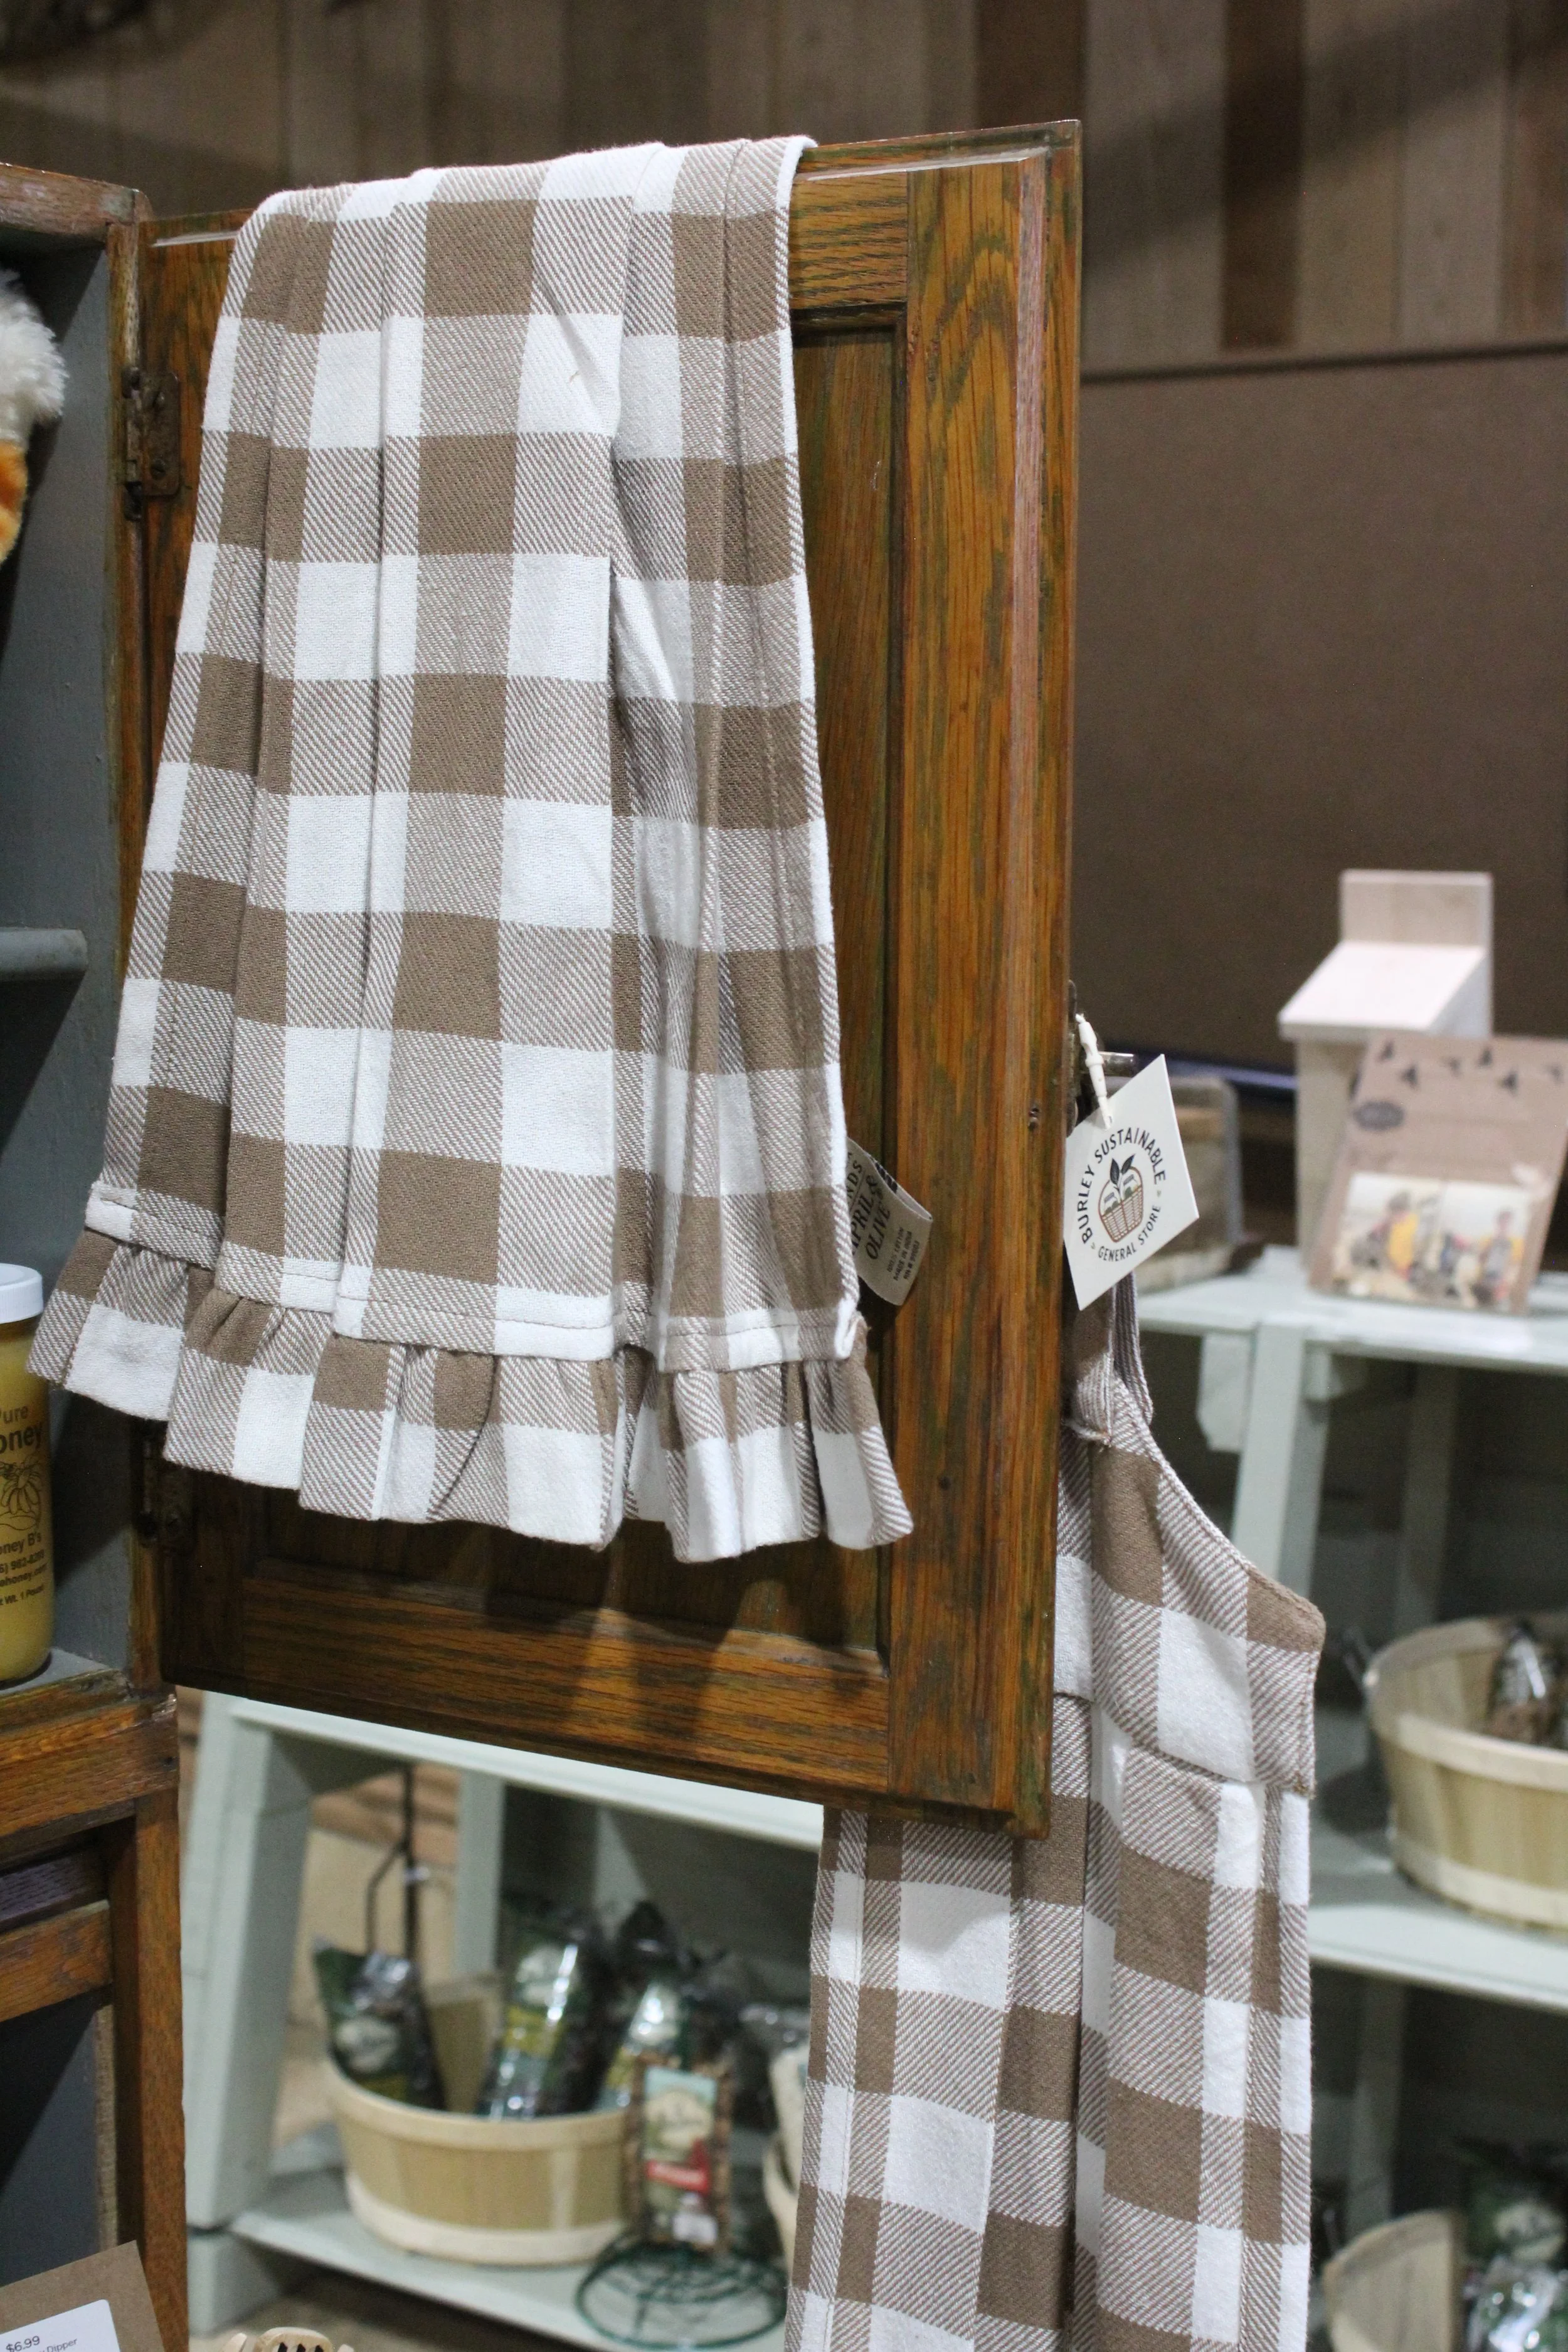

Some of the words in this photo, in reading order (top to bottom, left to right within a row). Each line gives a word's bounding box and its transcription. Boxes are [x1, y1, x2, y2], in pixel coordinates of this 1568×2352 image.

[847, 1159, 862, 1199] NDS
[1077, 1165, 1094, 1244] BURLEY
[1094, 1126, 1165, 1185] SUSTAINABLE
[865, 1204, 891, 1261] OLIVE
[1098, 1242, 1137, 1262] GENERAL
[1138, 1205, 1161, 1246] STORE
[0, 1405, 28, 1424] ure
[6, 2335, 40, 2352] $6.99
[46, 2338, 78, 2352] Dipper
